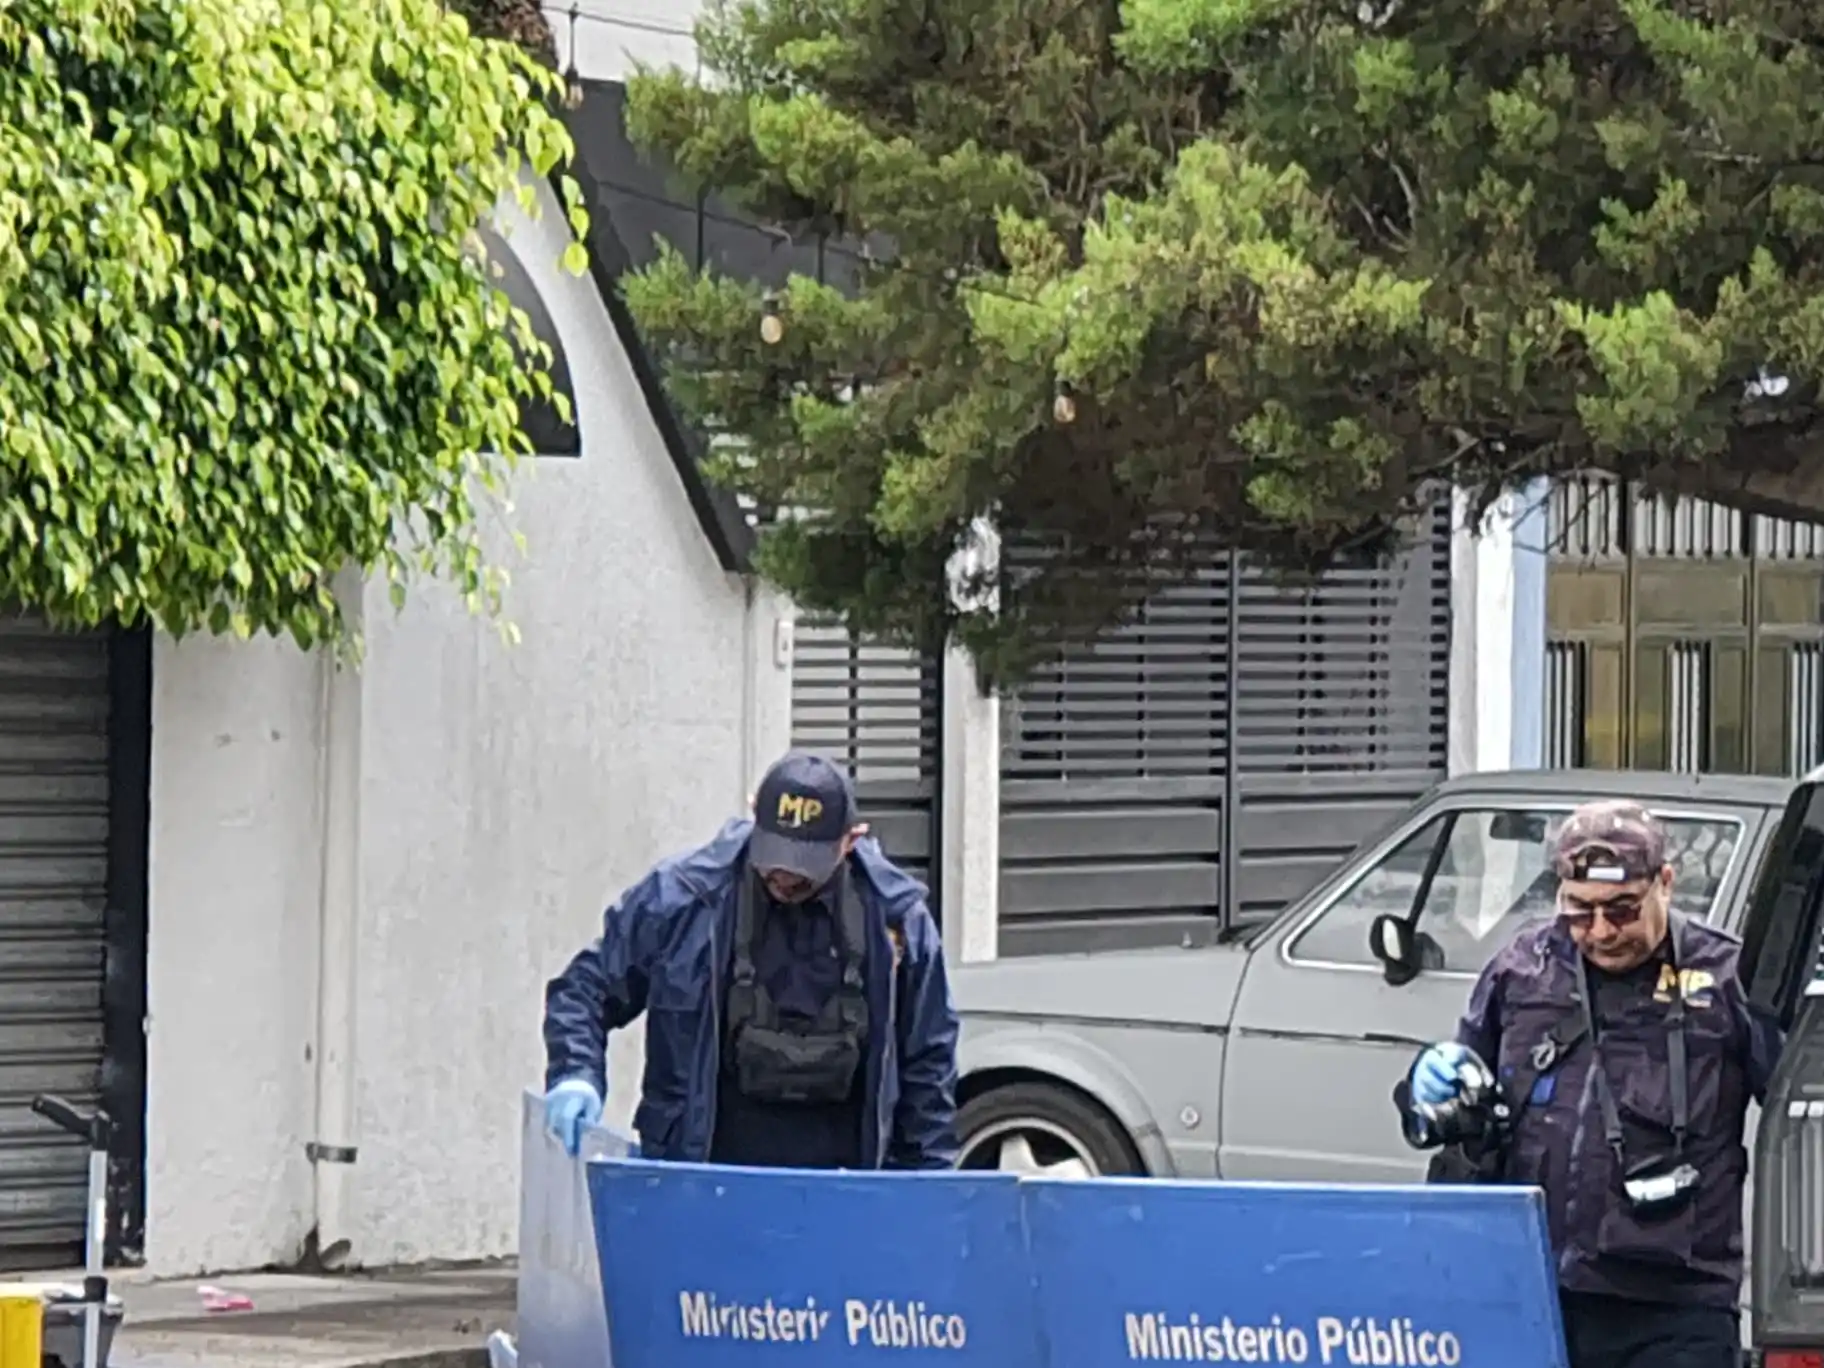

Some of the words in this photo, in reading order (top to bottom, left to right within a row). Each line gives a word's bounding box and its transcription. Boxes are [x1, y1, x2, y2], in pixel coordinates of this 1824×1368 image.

[777, 792, 823, 828] MP
[844, 1298, 967, 1349] Público
[1124, 1311, 1310, 1364] Ministerio
[1316, 1315, 1461, 1368] Público
